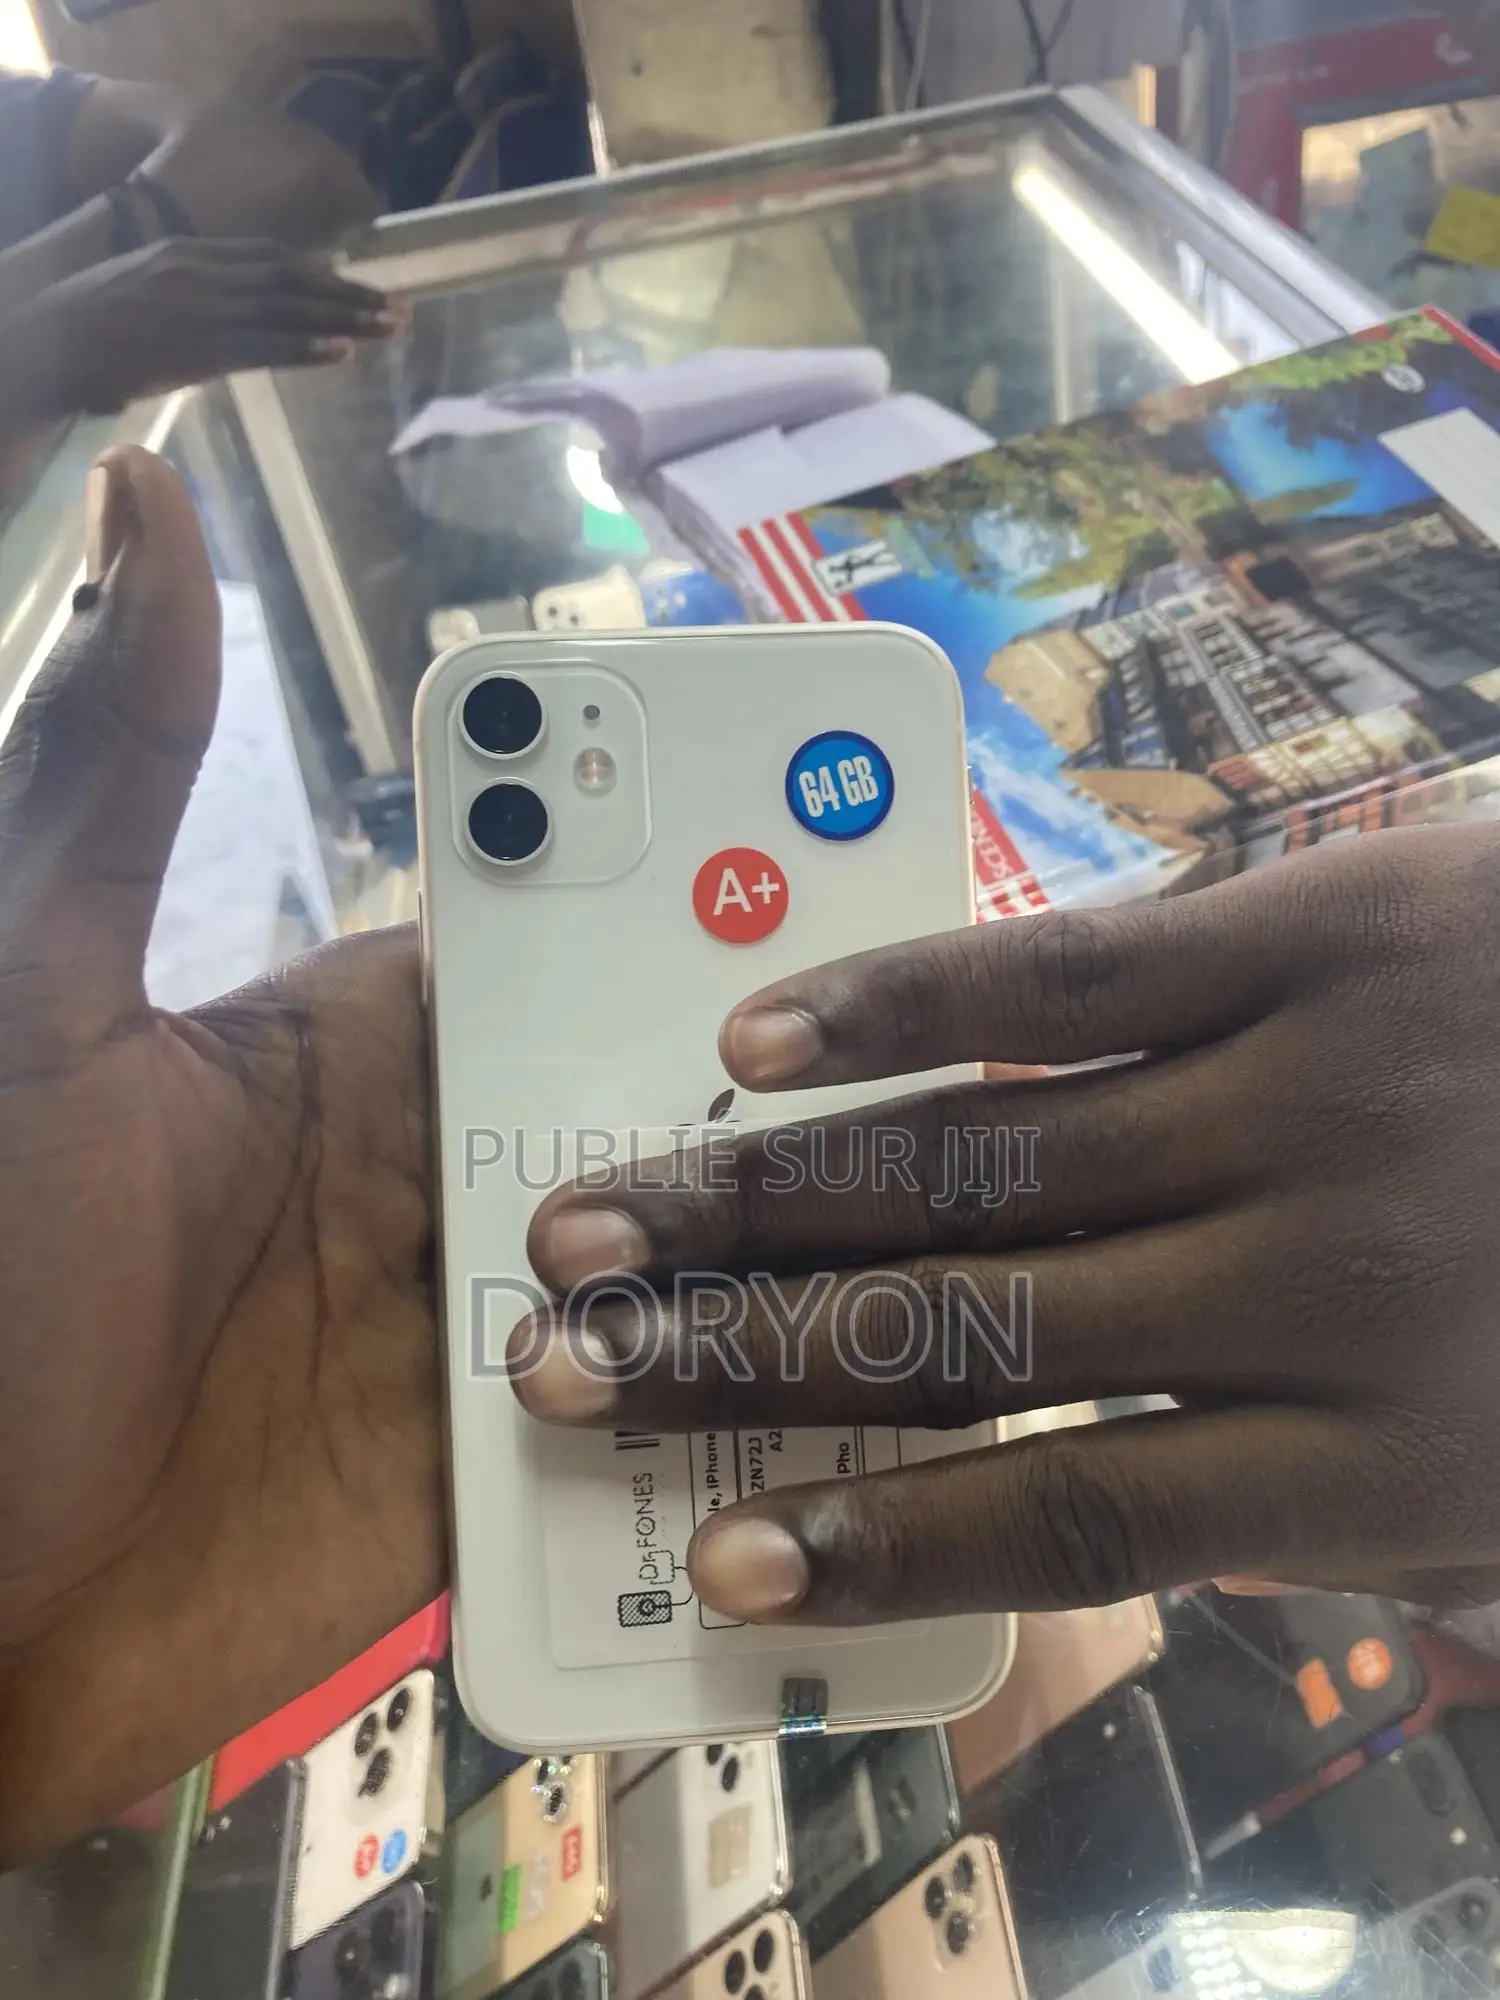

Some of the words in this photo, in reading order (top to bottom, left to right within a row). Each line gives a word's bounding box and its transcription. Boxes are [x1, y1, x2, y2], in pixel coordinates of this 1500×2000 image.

[798, 766, 841, 818] 64
[837, 755, 879, 807] GB
[713, 867, 780, 916] A+
[768, 1426, 783, 1452] A2
[836, 1441, 851, 1474] Pho
[749, 1437, 765, 1496] ZN72J
[707, 1492, 723, 1512] le,
